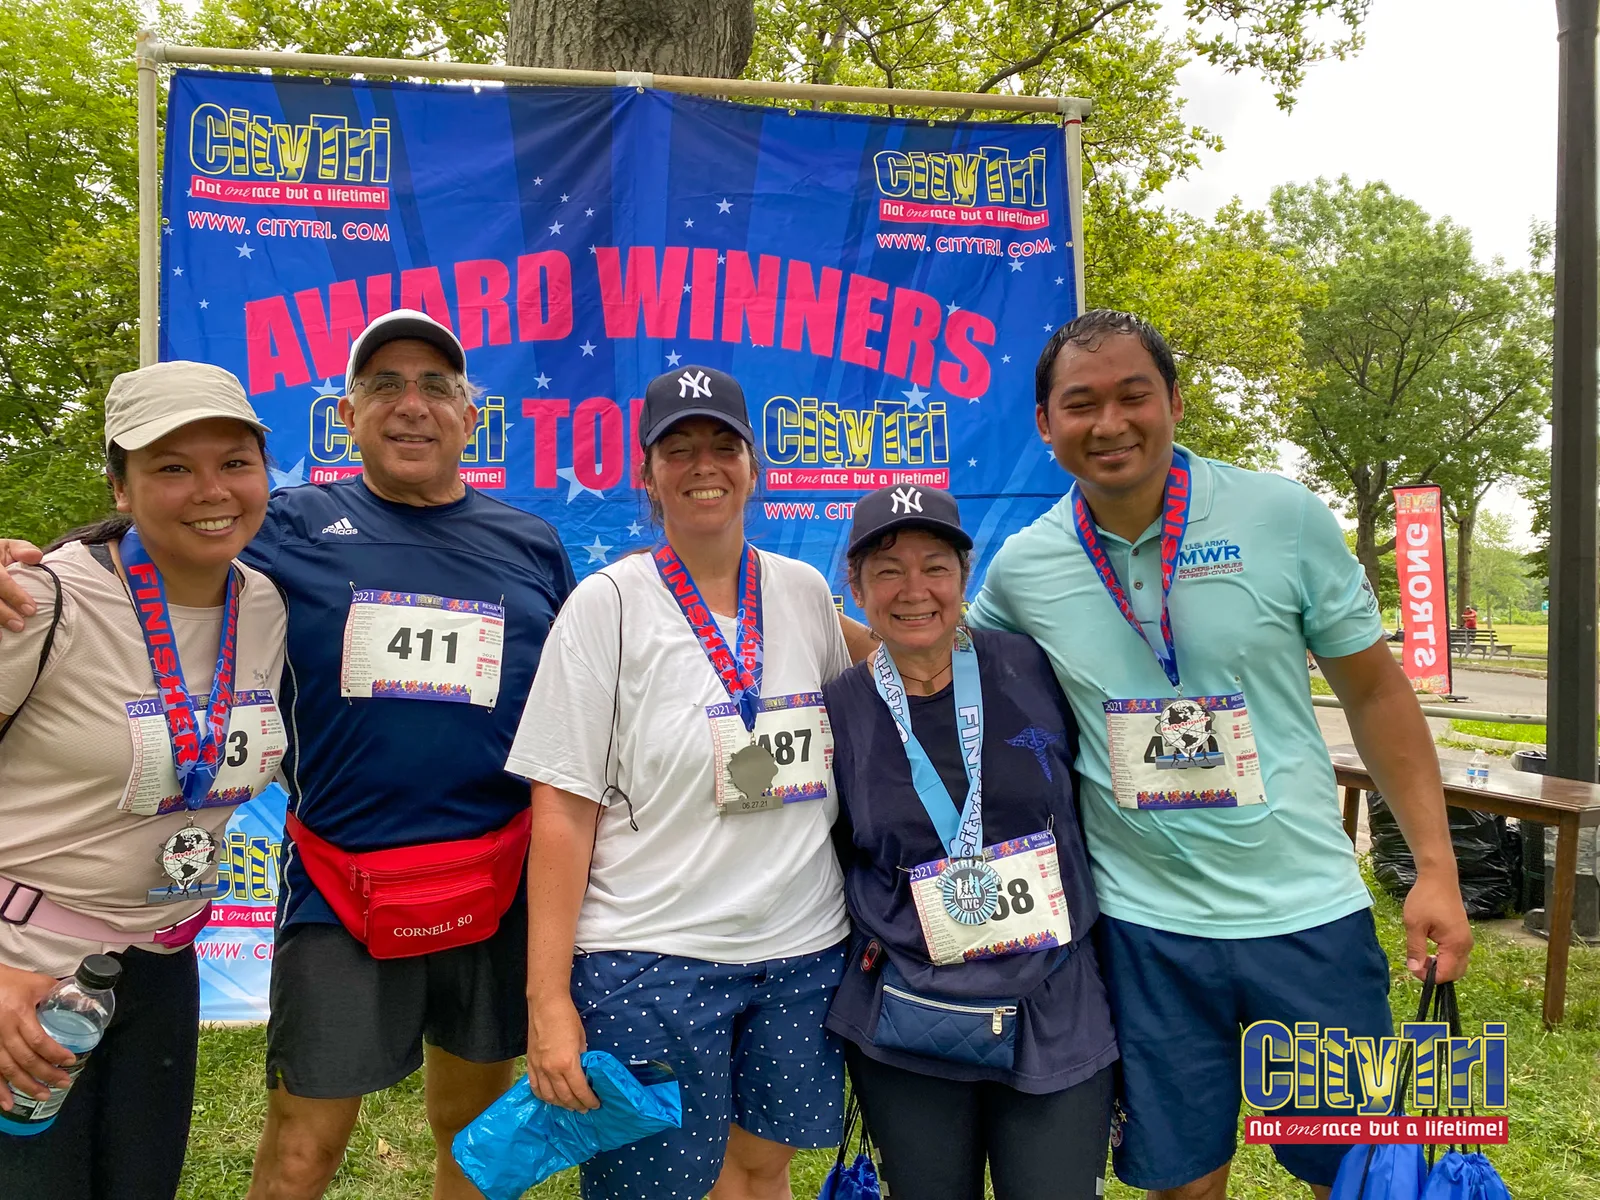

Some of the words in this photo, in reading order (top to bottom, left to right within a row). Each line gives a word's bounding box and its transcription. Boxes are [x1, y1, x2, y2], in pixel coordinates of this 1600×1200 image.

[189, 103, 391, 183] CityTri
[873, 146, 1047, 208] CityTri
[195, 178, 222, 195] Not
[225, 186, 251, 197] one
[252, 186, 281, 199] race
[286, 186, 309, 200] but
[314, 189, 323, 201] a
[328, 188, 386, 203] lifetime!
[188, 210, 251, 235] WWW.
[342, 222, 391, 242] COM
[882, 203, 904, 217] Not
[907, 208, 930, 218] one
[930, 209, 956, 221] race
[961, 209, 982, 221] but
[986, 211, 994, 221] a
[997, 211, 1045, 226] lifetime!
[876, 233, 931, 252] WWW.
[1008, 237, 1052, 258] COM
[244, 248, 574, 396] AWARD
[594, 246, 997, 400] WINNERS
[522, 396, 646, 491] TO
[763, 395, 950, 469] CityTri
[314, 470, 338, 482] Not
[459, 471, 502, 483] etime!
[769, 472, 793, 485] Not
[796, 474, 820, 484] one
[820, 474, 848, 485] race
[853, 472, 875, 485] but
[879, 475, 888, 485] a
[892, 472, 946, 485] lifetime!
[763, 502, 820, 520] WWW.
[1161, 466, 1190, 600] FINISH
[1204, 539, 1229, 548] ARMY
[1179, 545, 1241, 567] MWR
[352, 591, 374, 602] 2021
[655, 544, 745, 694] FINISHER
[387, 627, 459, 664] 411
[129, 563, 201, 765] FINISHER
[128, 702, 157, 716] 2021
[708, 705, 731, 717] 2021
[1105, 702, 1122, 712] 2021
[974, 860, 1003, 885] RUNS
[211, 908, 224, 921] ot
[227, 911, 252, 920] one
[961, 899, 980, 909] NYC
[393, 921, 454, 938] CORNELL
[457, 914, 473, 928] 80
